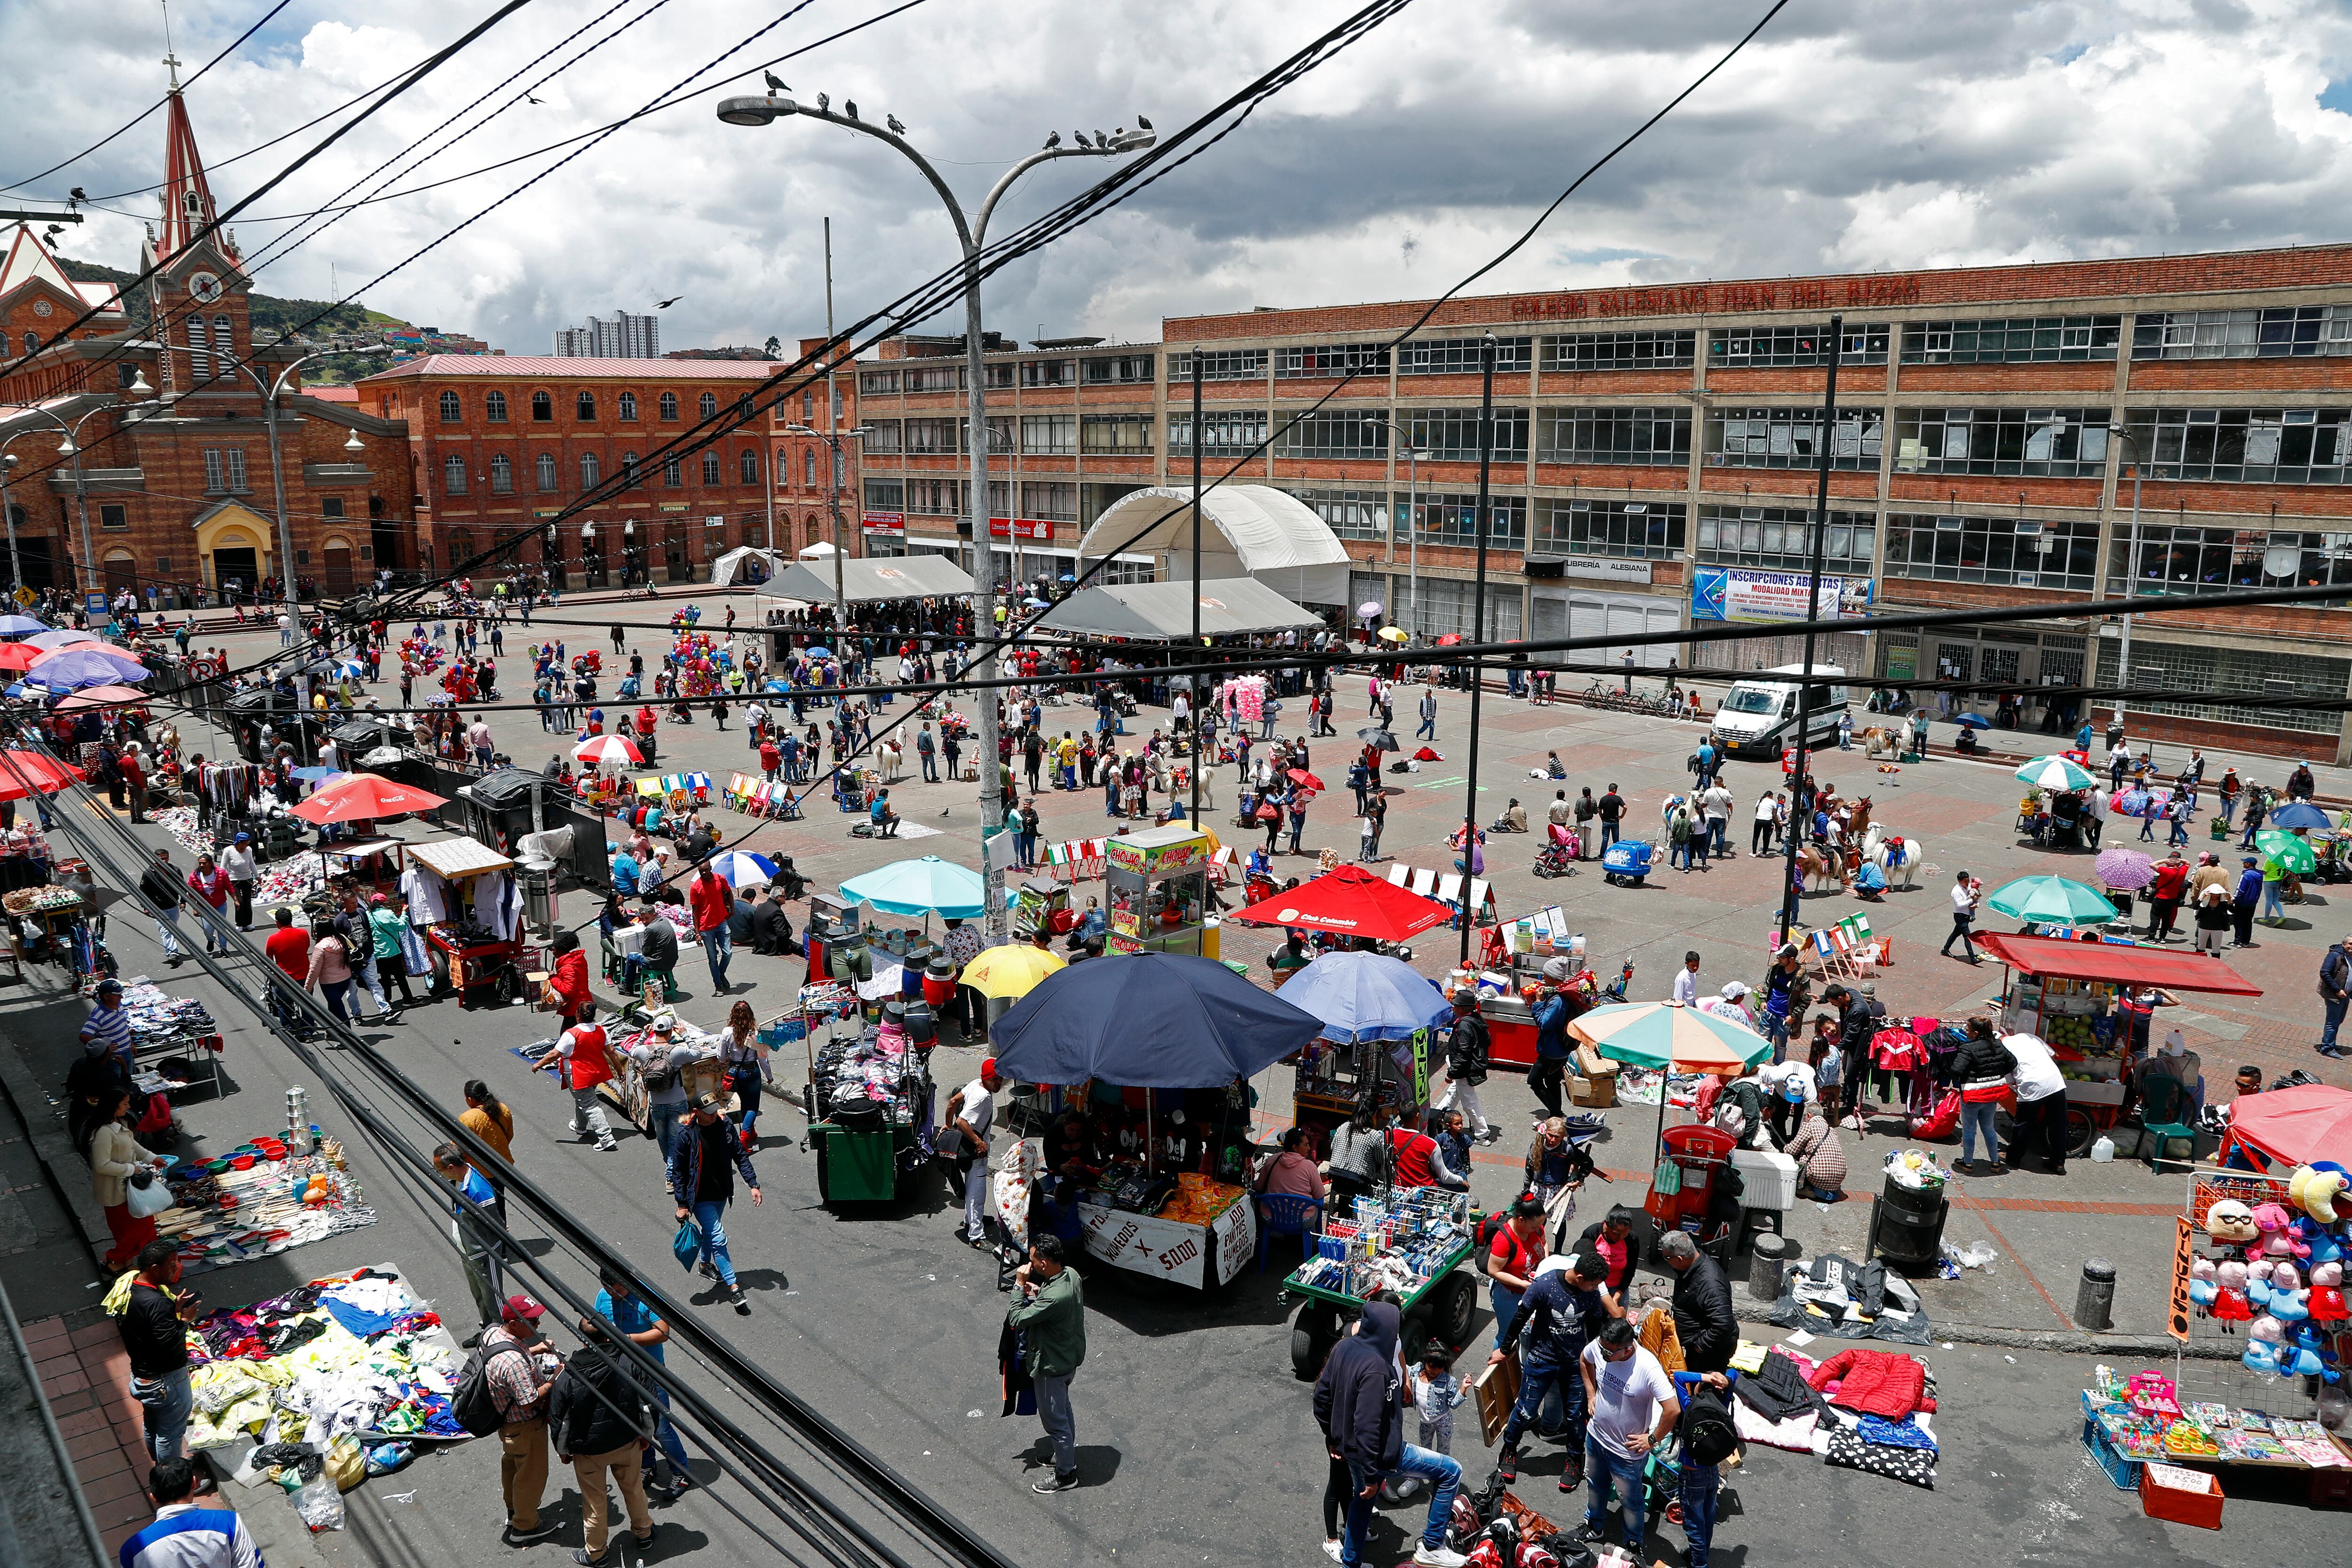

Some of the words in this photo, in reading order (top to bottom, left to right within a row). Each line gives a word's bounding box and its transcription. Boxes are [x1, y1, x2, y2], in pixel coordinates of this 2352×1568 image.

[1511, 296, 1587, 316] COLEGIO
[1599, 288, 1708, 311] SALESIANO
[1721, 285, 1776, 304] JUAN
[1791, 282, 1831, 302] DEL
[1848, 277, 1920, 298] RIZZO
[1566, 559, 1600, 569] LIBRERÍA
[1610, 563, 1648, 572] ALESIANA
[1729, 571, 1794, 586] INSCRIPCIONES
[1751, 584, 1789, 595] MODALIDAD
[1791, 588, 1812, 597] MIXTA
[1806, 720, 1828, 729] POLICIA
[1300, 913, 1319, 922] Club
[1319, 916, 1358, 927] Colombia
[1229, 1204, 1245, 1227] 100
[1105, 1220, 1139, 1262] HUMEDOS
[1134, 1237, 1154, 1258] X
[1224, 1231, 1249, 1263] HUMEDOS
[1225, 1262, 1232, 1279] X
[524, 1296, 536, 1308] H
[1549, 1325, 1582, 1335] adidas
[1598, 1368, 1630, 1392] SKATEBOARDING
[2151, 1465, 2203, 1480] SORPRESAS
